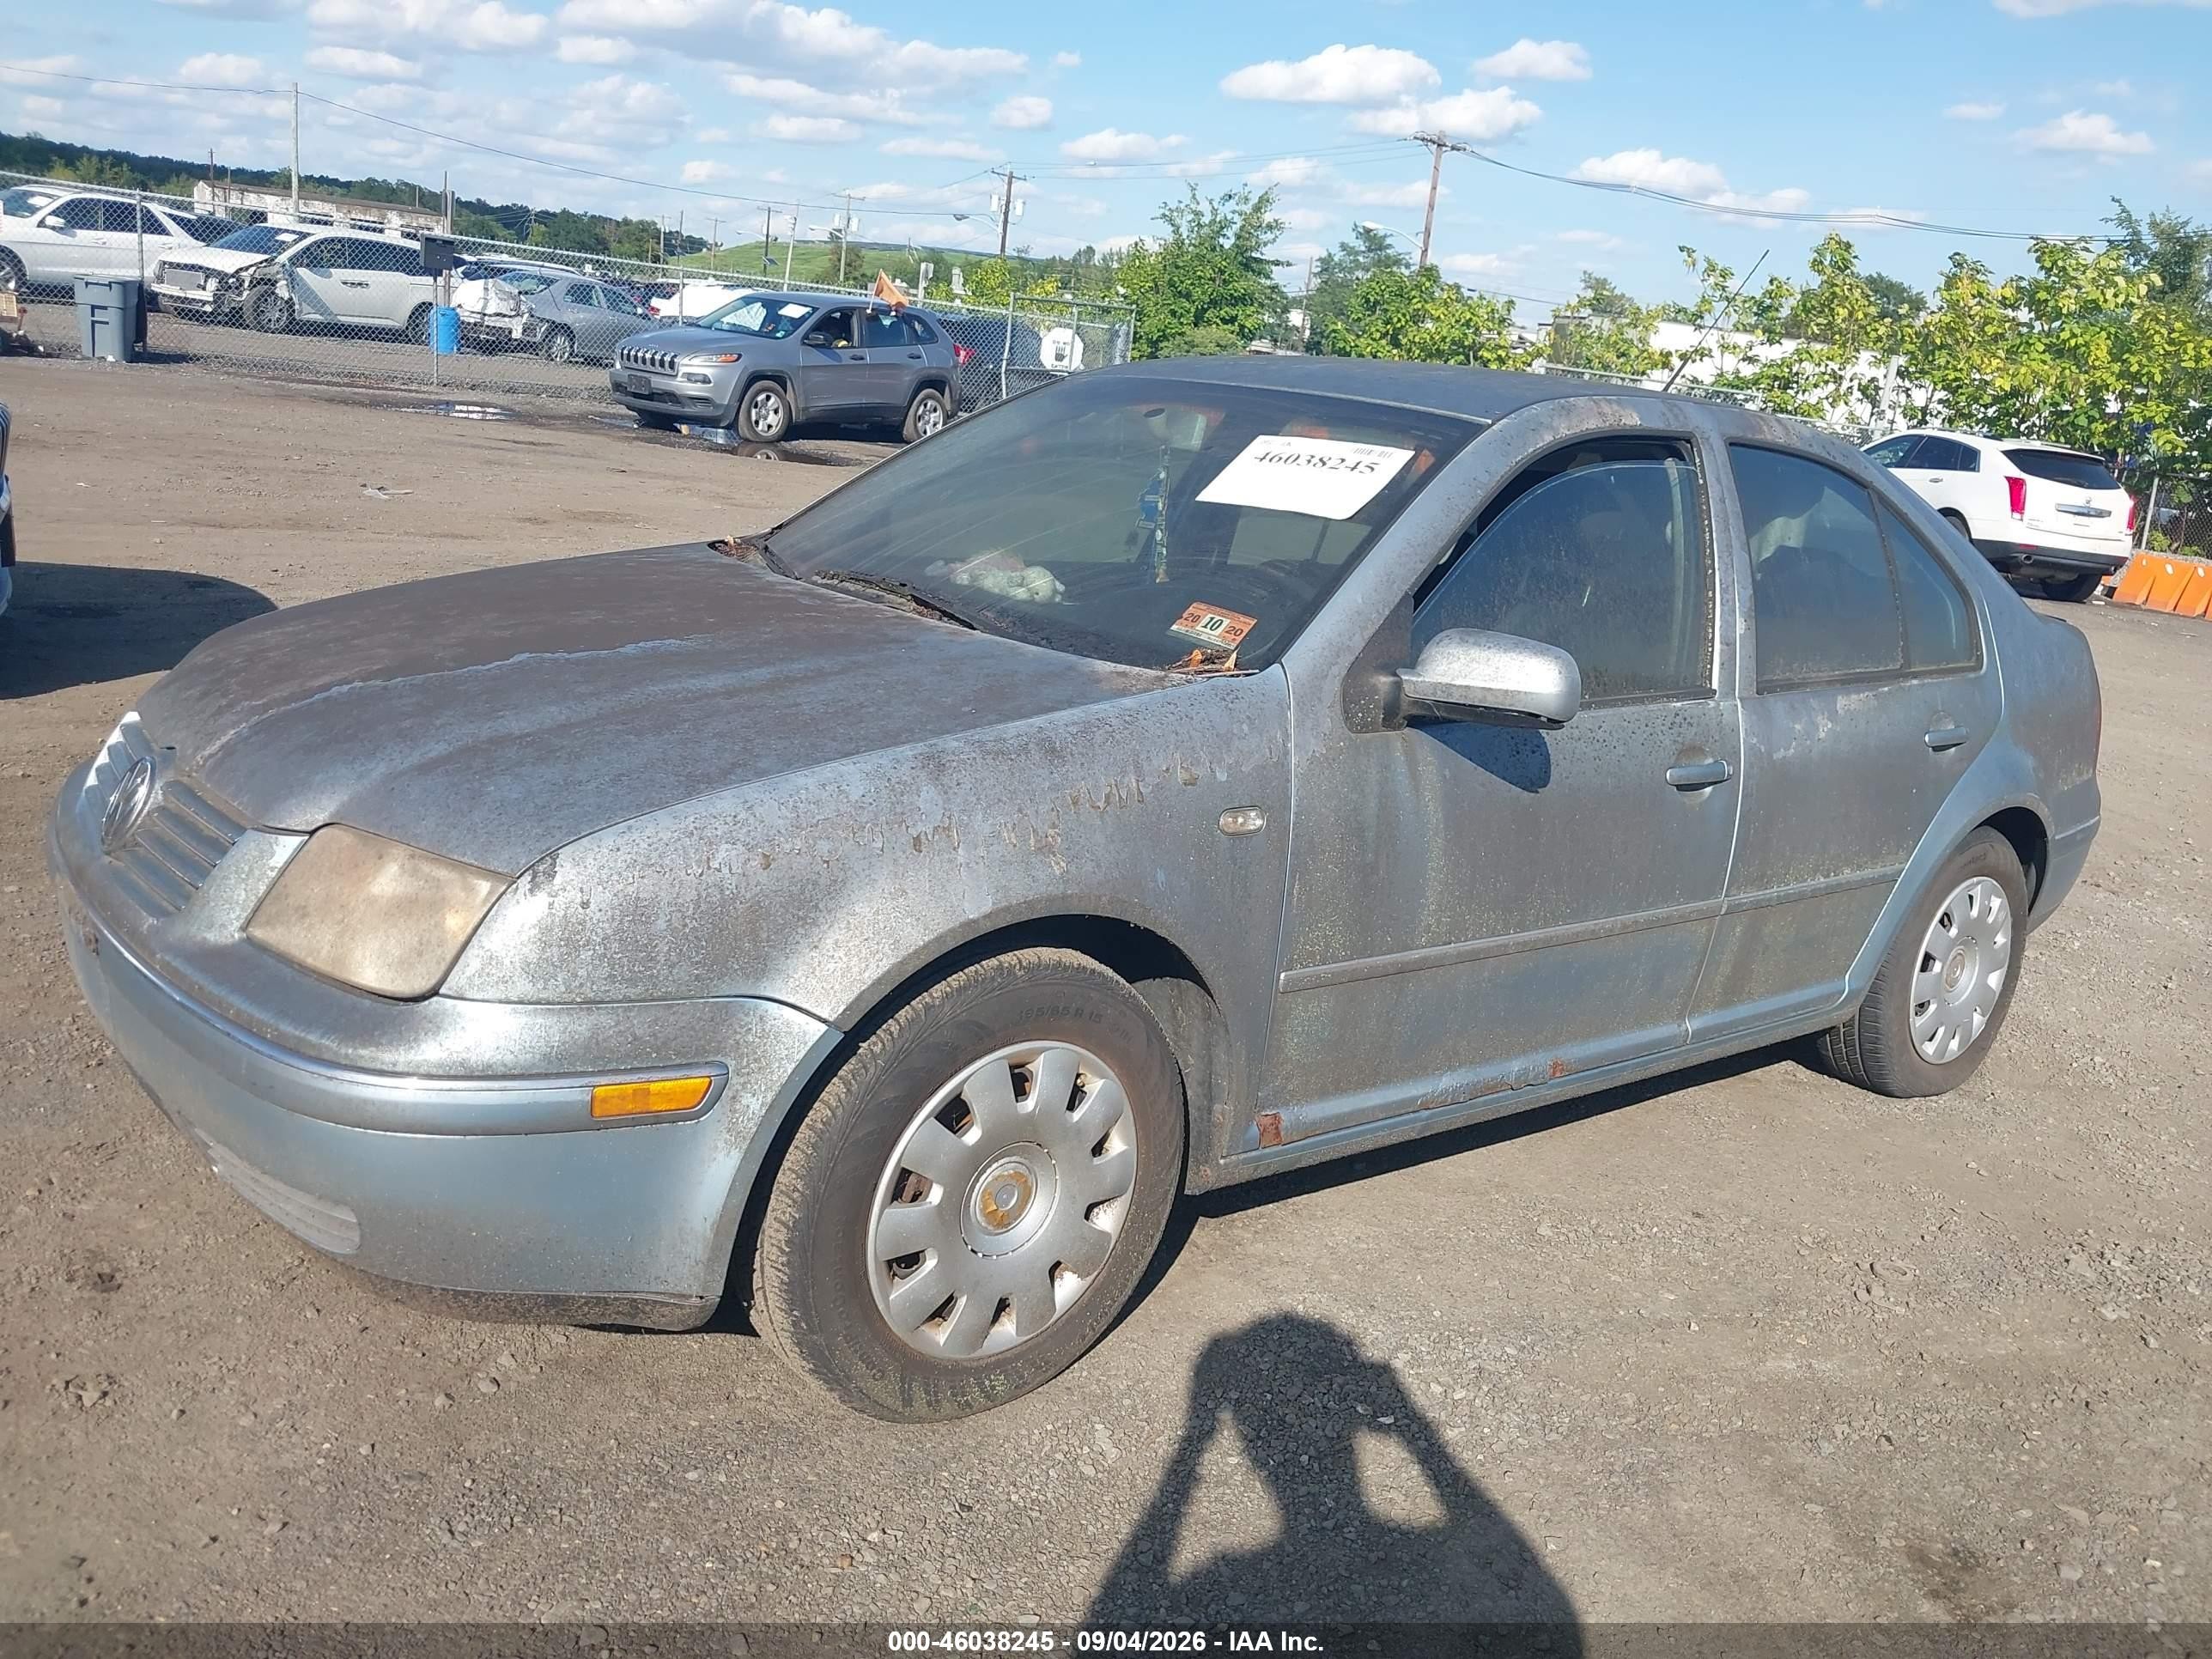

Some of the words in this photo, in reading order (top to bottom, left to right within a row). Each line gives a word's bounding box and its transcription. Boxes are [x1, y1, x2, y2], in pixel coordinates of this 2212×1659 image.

[1254, 450, 1381, 475] 46038245
[1183, 612, 1201, 623] 20
[1201, 617, 1223, 631] 10
[1225, 625, 1244, 637] 20
